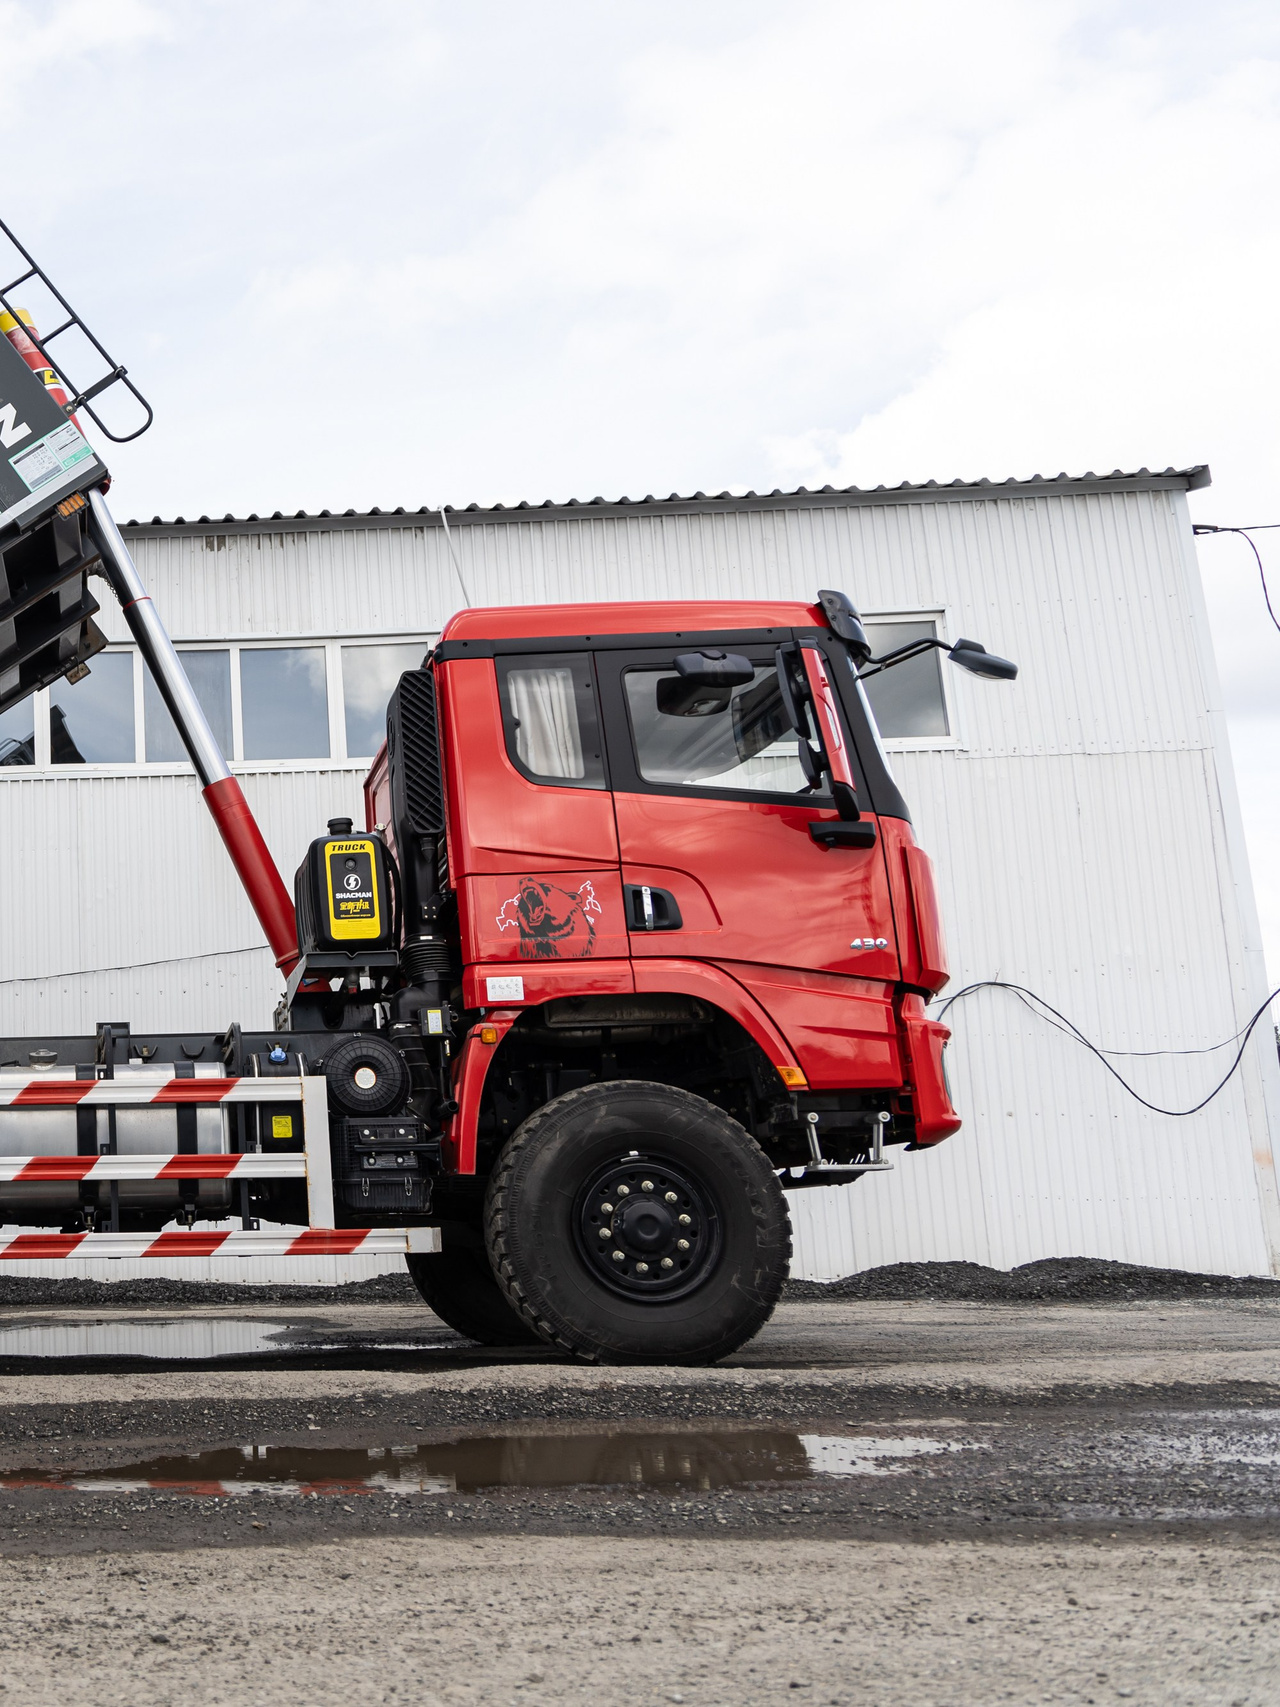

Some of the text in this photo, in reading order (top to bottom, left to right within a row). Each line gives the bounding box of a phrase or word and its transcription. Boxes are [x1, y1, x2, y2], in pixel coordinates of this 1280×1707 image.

[332, 843, 366, 851] TRUCK
[335, 891, 372, 899] SHACMAN
[850, 937, 888, 950] 430
